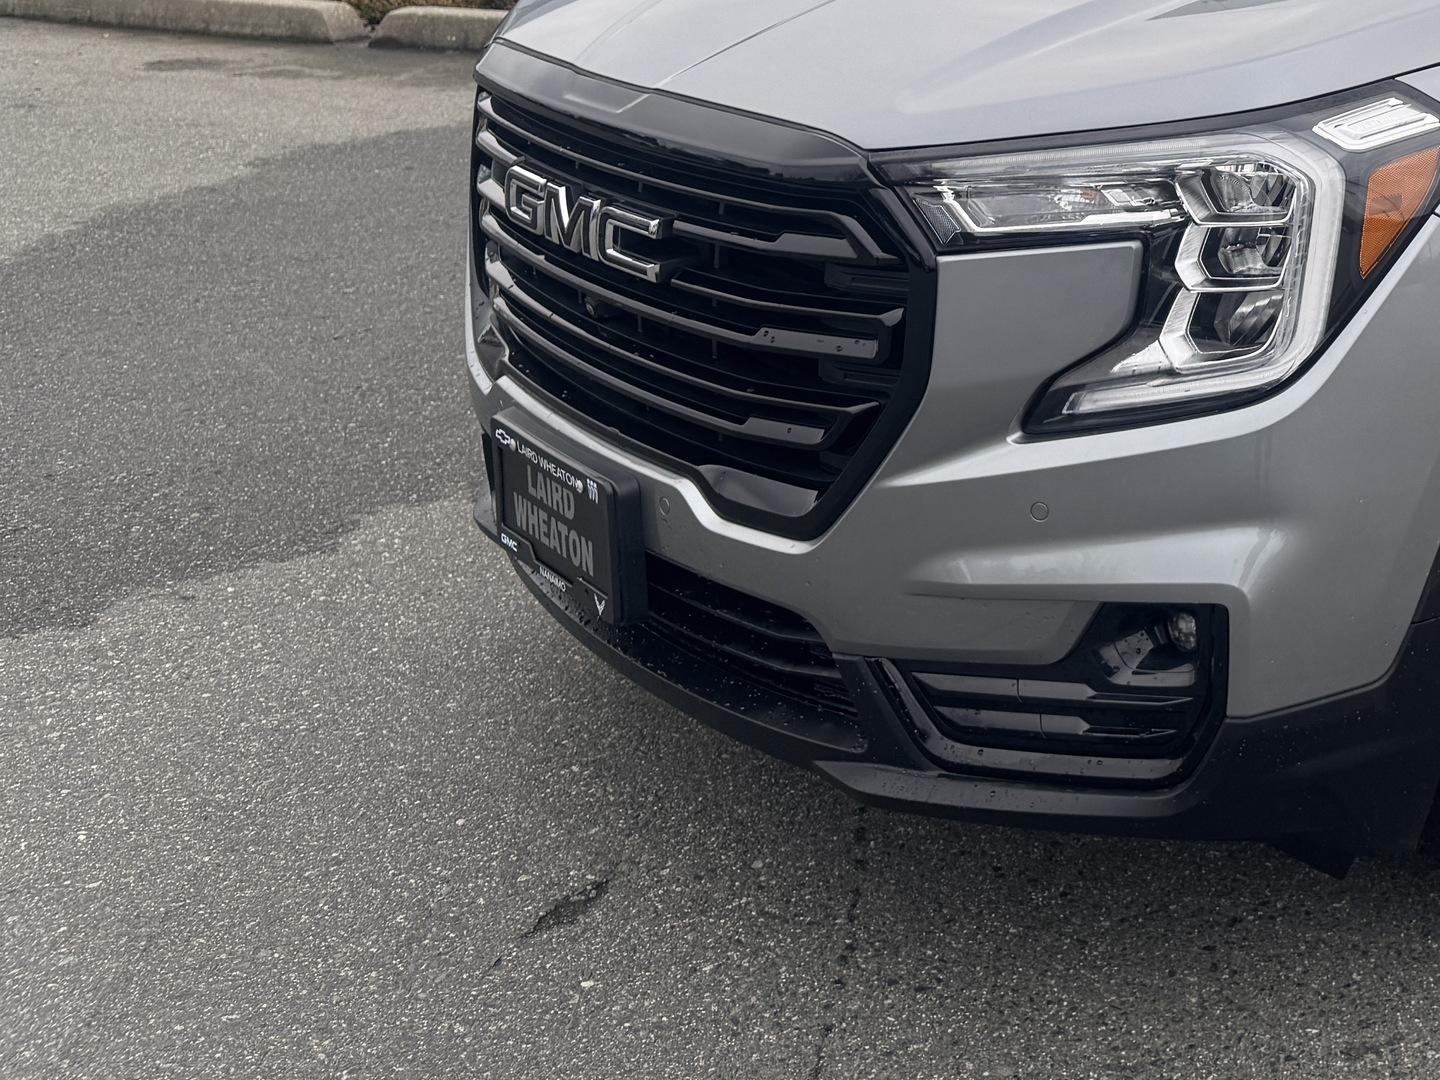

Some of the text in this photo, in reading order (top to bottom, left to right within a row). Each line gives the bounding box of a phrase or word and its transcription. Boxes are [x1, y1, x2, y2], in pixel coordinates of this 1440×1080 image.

[505, 165, 661, 284] GMC
[516, 440, 578, 487] LAIRD WHEATON
[526, 464, 575, 520] LAIRD
[501, 532, 518, 552] GMC
[513, 491, 594, 577] WHEATON
[539, 566, 566, 592] NANAIMO
